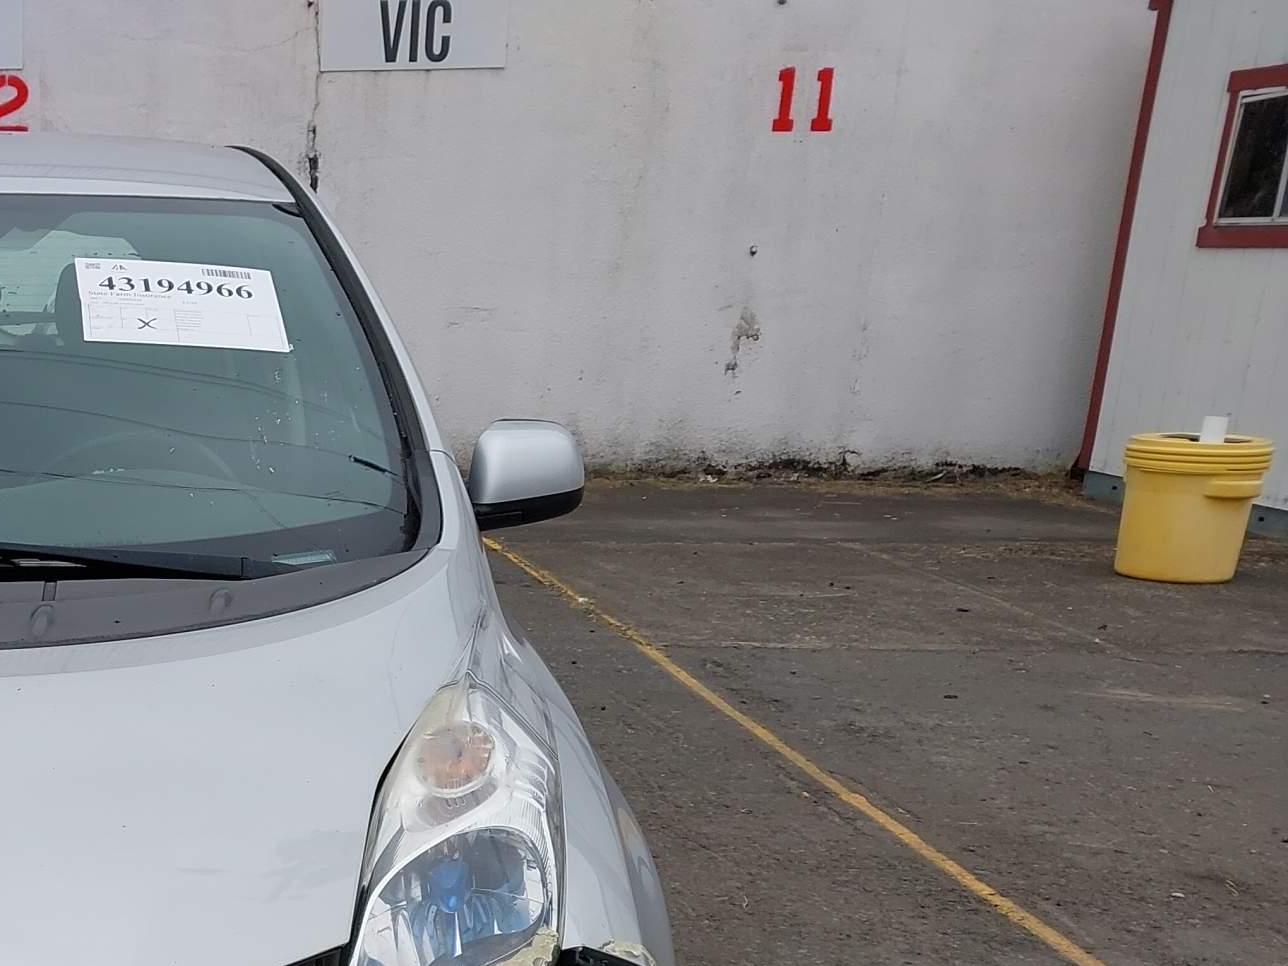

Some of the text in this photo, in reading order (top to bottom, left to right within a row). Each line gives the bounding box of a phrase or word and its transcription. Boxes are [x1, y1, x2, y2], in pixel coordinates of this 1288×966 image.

[379, 0, 453, 63] VIC
[771, 67, 834, 133] 11
[98, 275, 254, 300] 43194966
